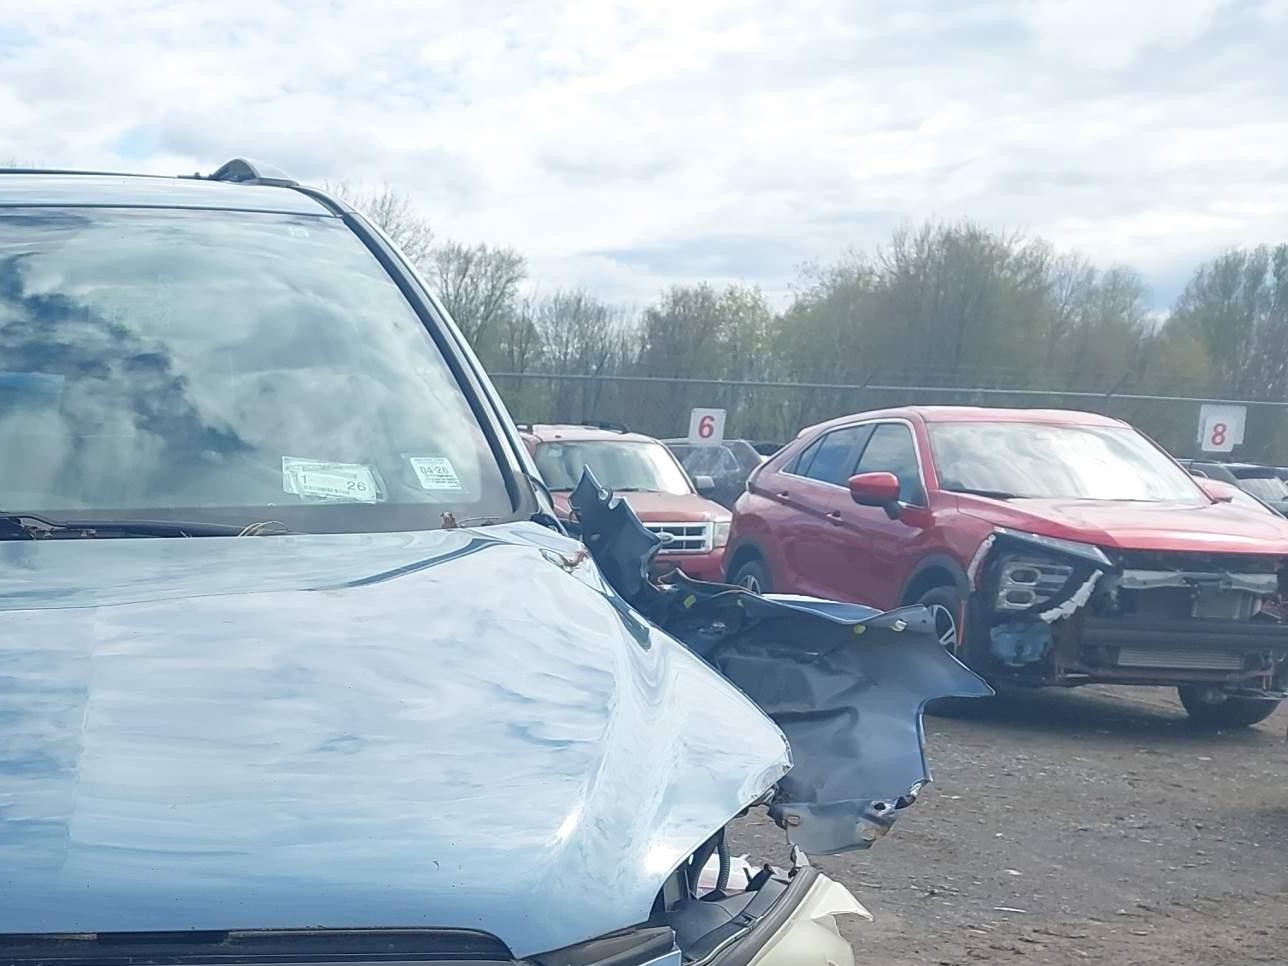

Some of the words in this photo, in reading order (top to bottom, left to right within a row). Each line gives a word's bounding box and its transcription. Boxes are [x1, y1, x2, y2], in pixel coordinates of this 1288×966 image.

[698, 415, 715, 439] 6
[1212, 423, 1226, 446] 8
[346, 480, 368, 492] 26
